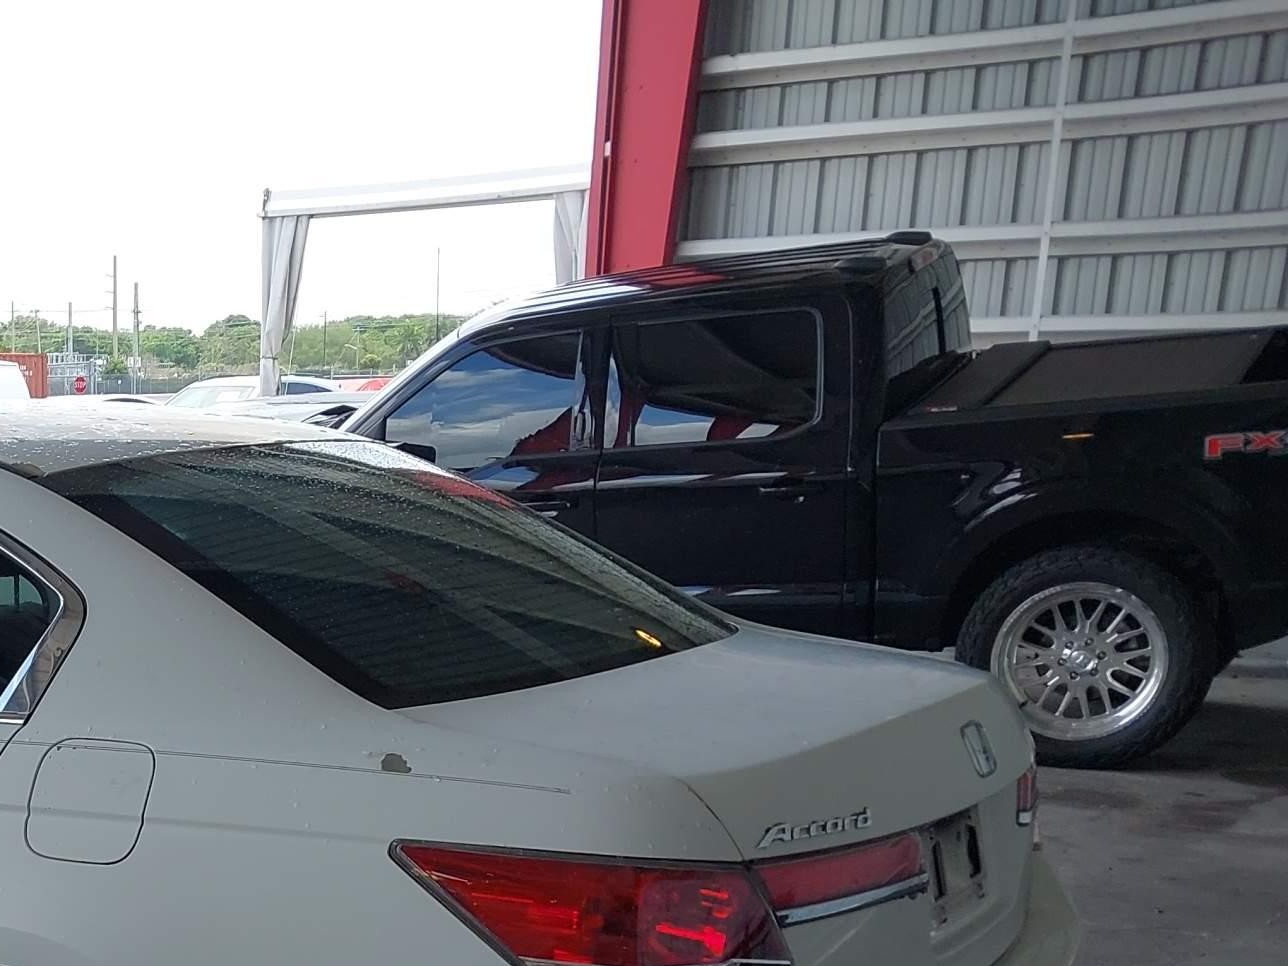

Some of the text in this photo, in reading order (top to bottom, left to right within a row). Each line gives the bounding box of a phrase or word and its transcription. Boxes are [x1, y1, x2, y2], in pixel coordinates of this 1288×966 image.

[74, 380, 87, 389] STOP
[1203, 430, 1288, 460] FX
[756, 806, 872, 849] Accord
